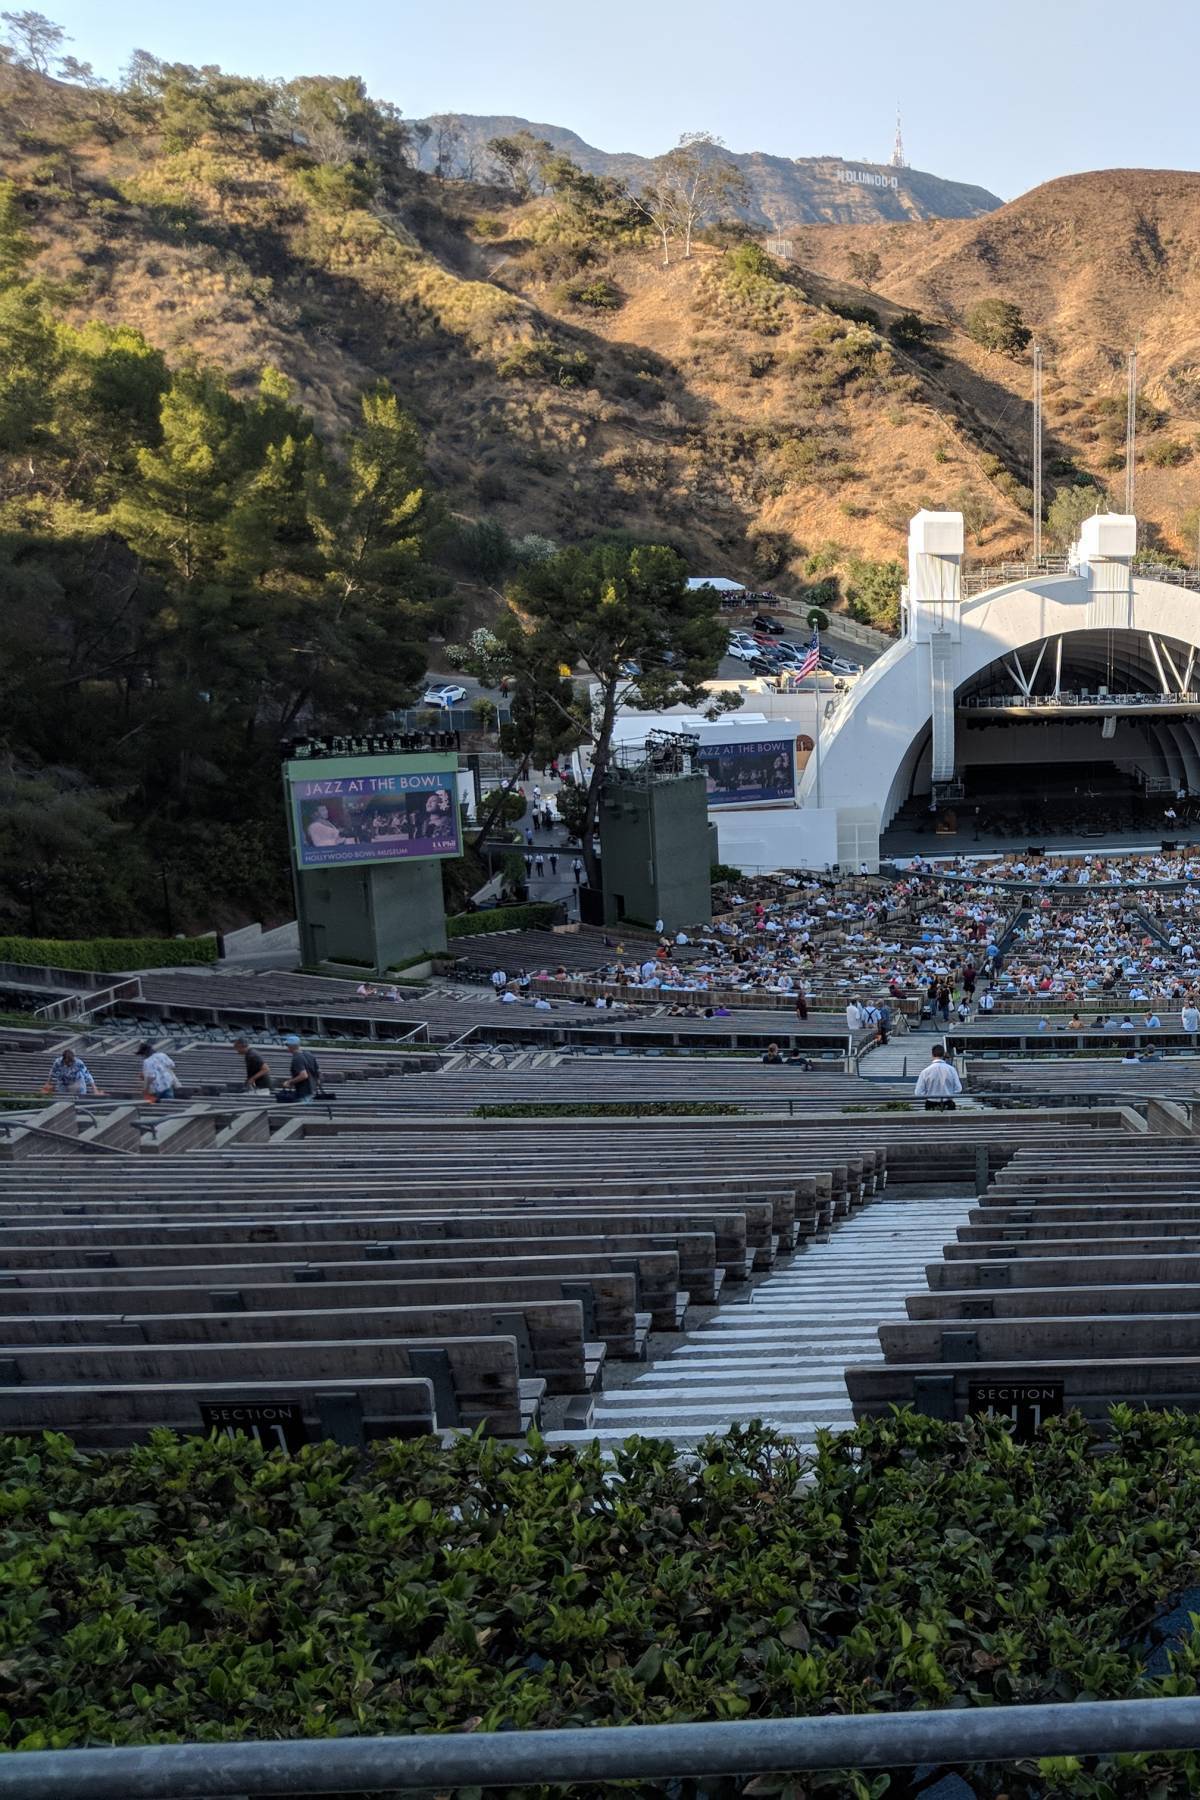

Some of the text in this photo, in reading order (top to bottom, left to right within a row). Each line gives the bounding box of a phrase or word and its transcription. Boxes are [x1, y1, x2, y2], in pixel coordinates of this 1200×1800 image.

[837, 170, 898, 189] HOLLYWOOD
[723, 746, 734, 754] AT
[738, 744, 755, 753] THE
[757, 742, 786, 752] BOWL
[305, 775, 443, 796] JAZZ AT THE BOWL
[305, 847, 408, 862] HOLLYWOOD BOWL MUSEUM
[976, 1389, 1054, 1400] SECTION
[210, 1407, 293, 1421] SECTION
